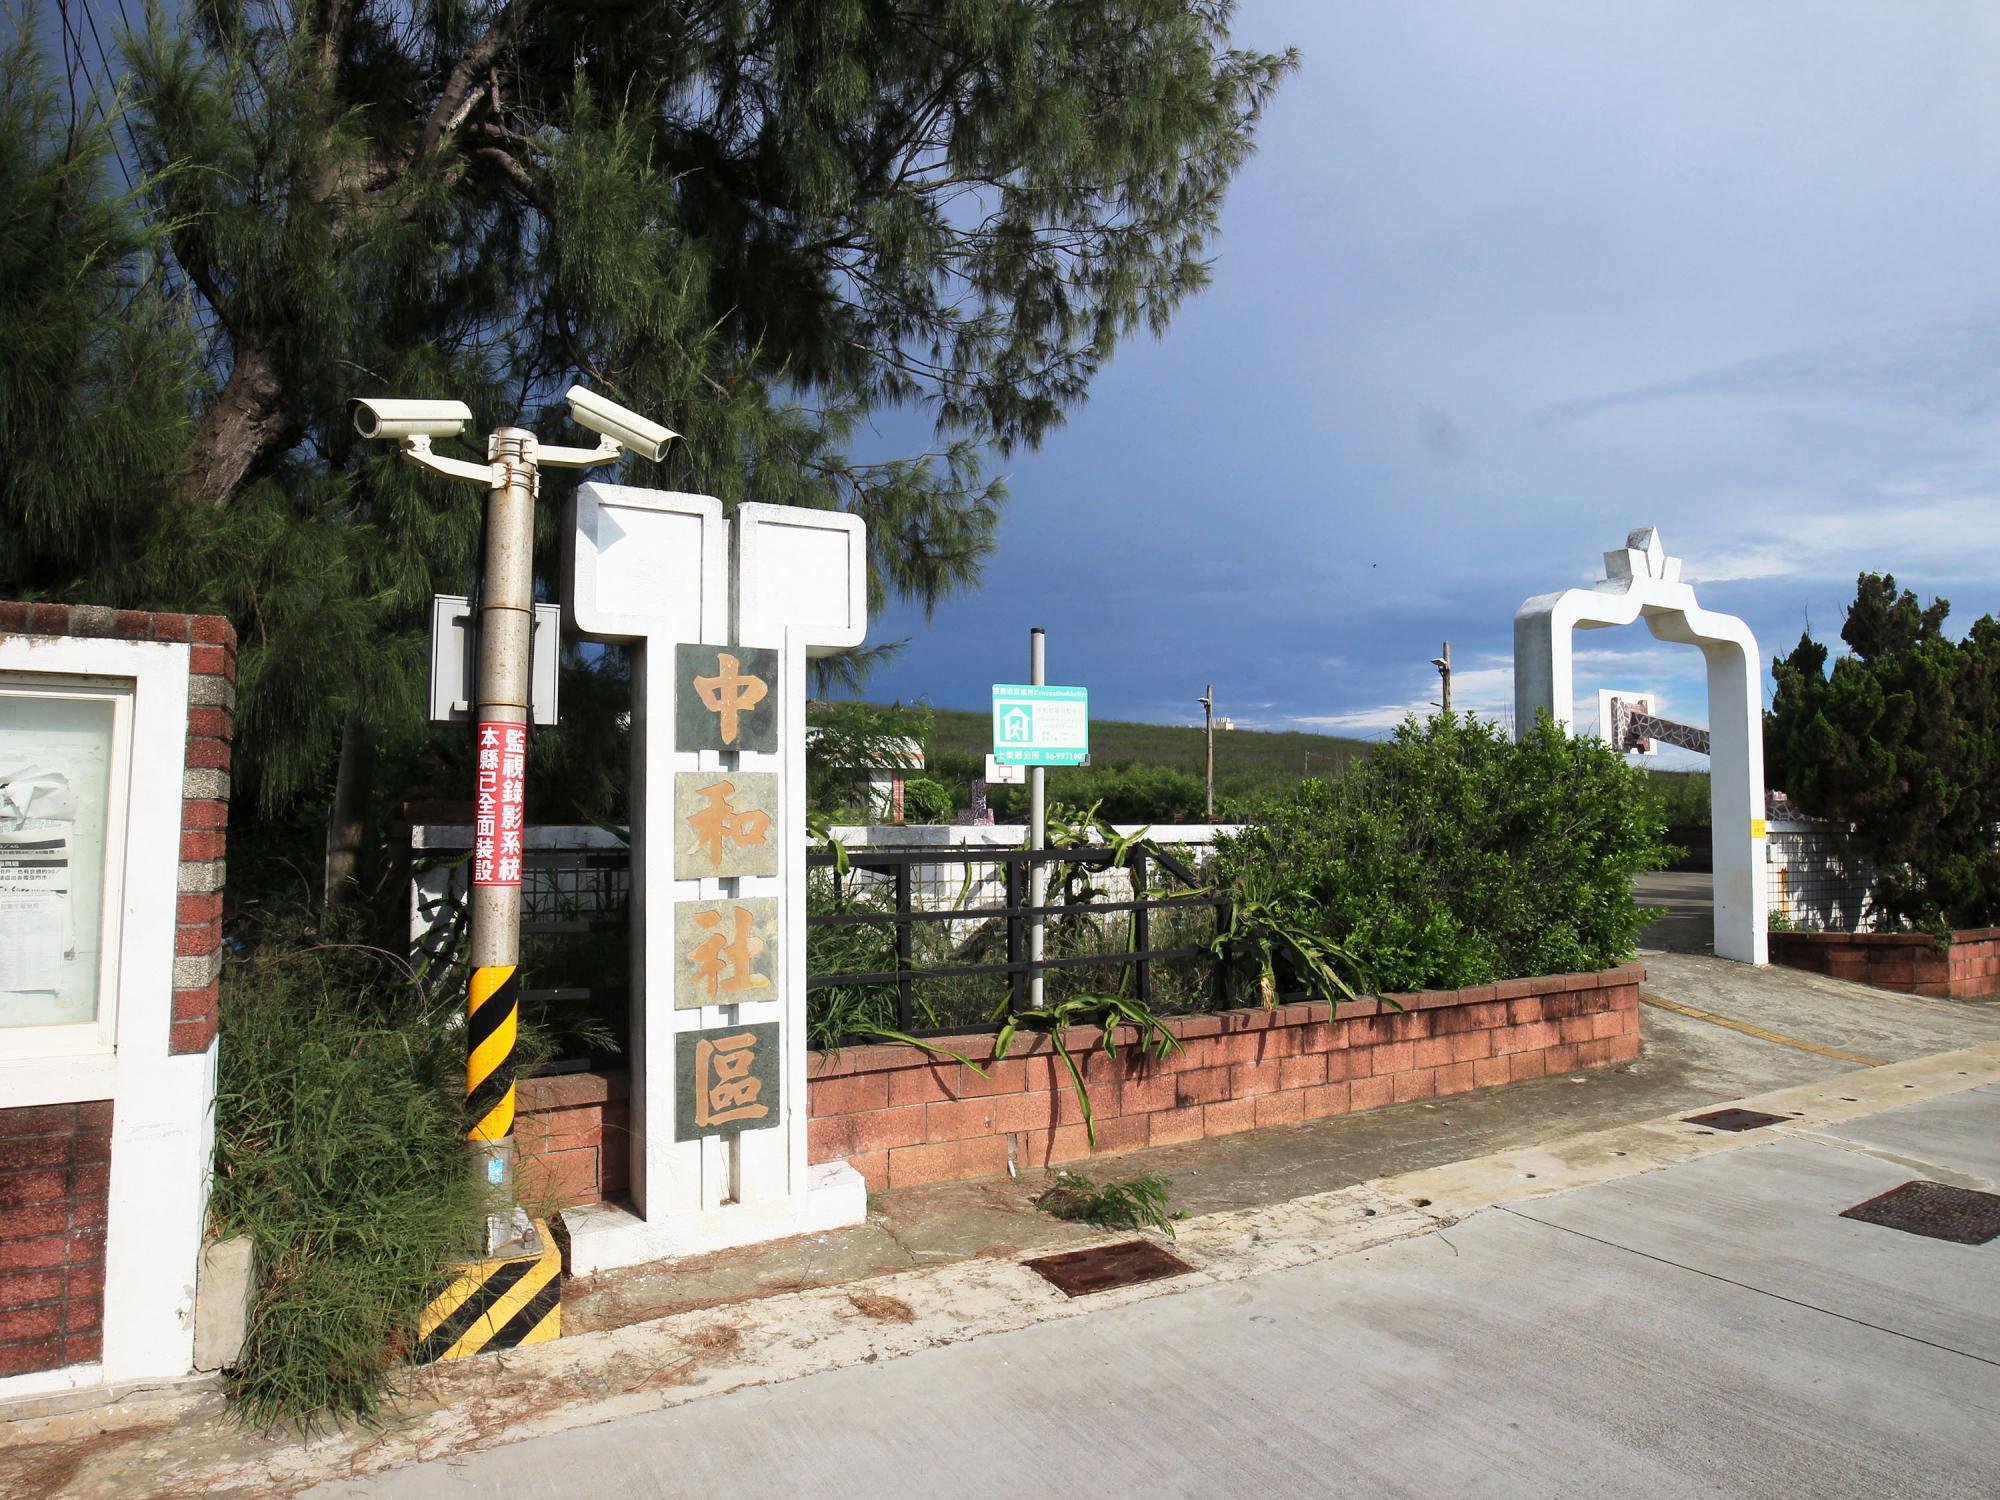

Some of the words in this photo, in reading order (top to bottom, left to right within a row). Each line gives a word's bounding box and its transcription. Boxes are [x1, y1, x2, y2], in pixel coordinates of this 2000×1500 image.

[474, 726, 500, 882] 本縣已全面裝設
[498, 728, 525, 882] 監視錄影系統
[685, 652, 773, 1127] 中和社區
